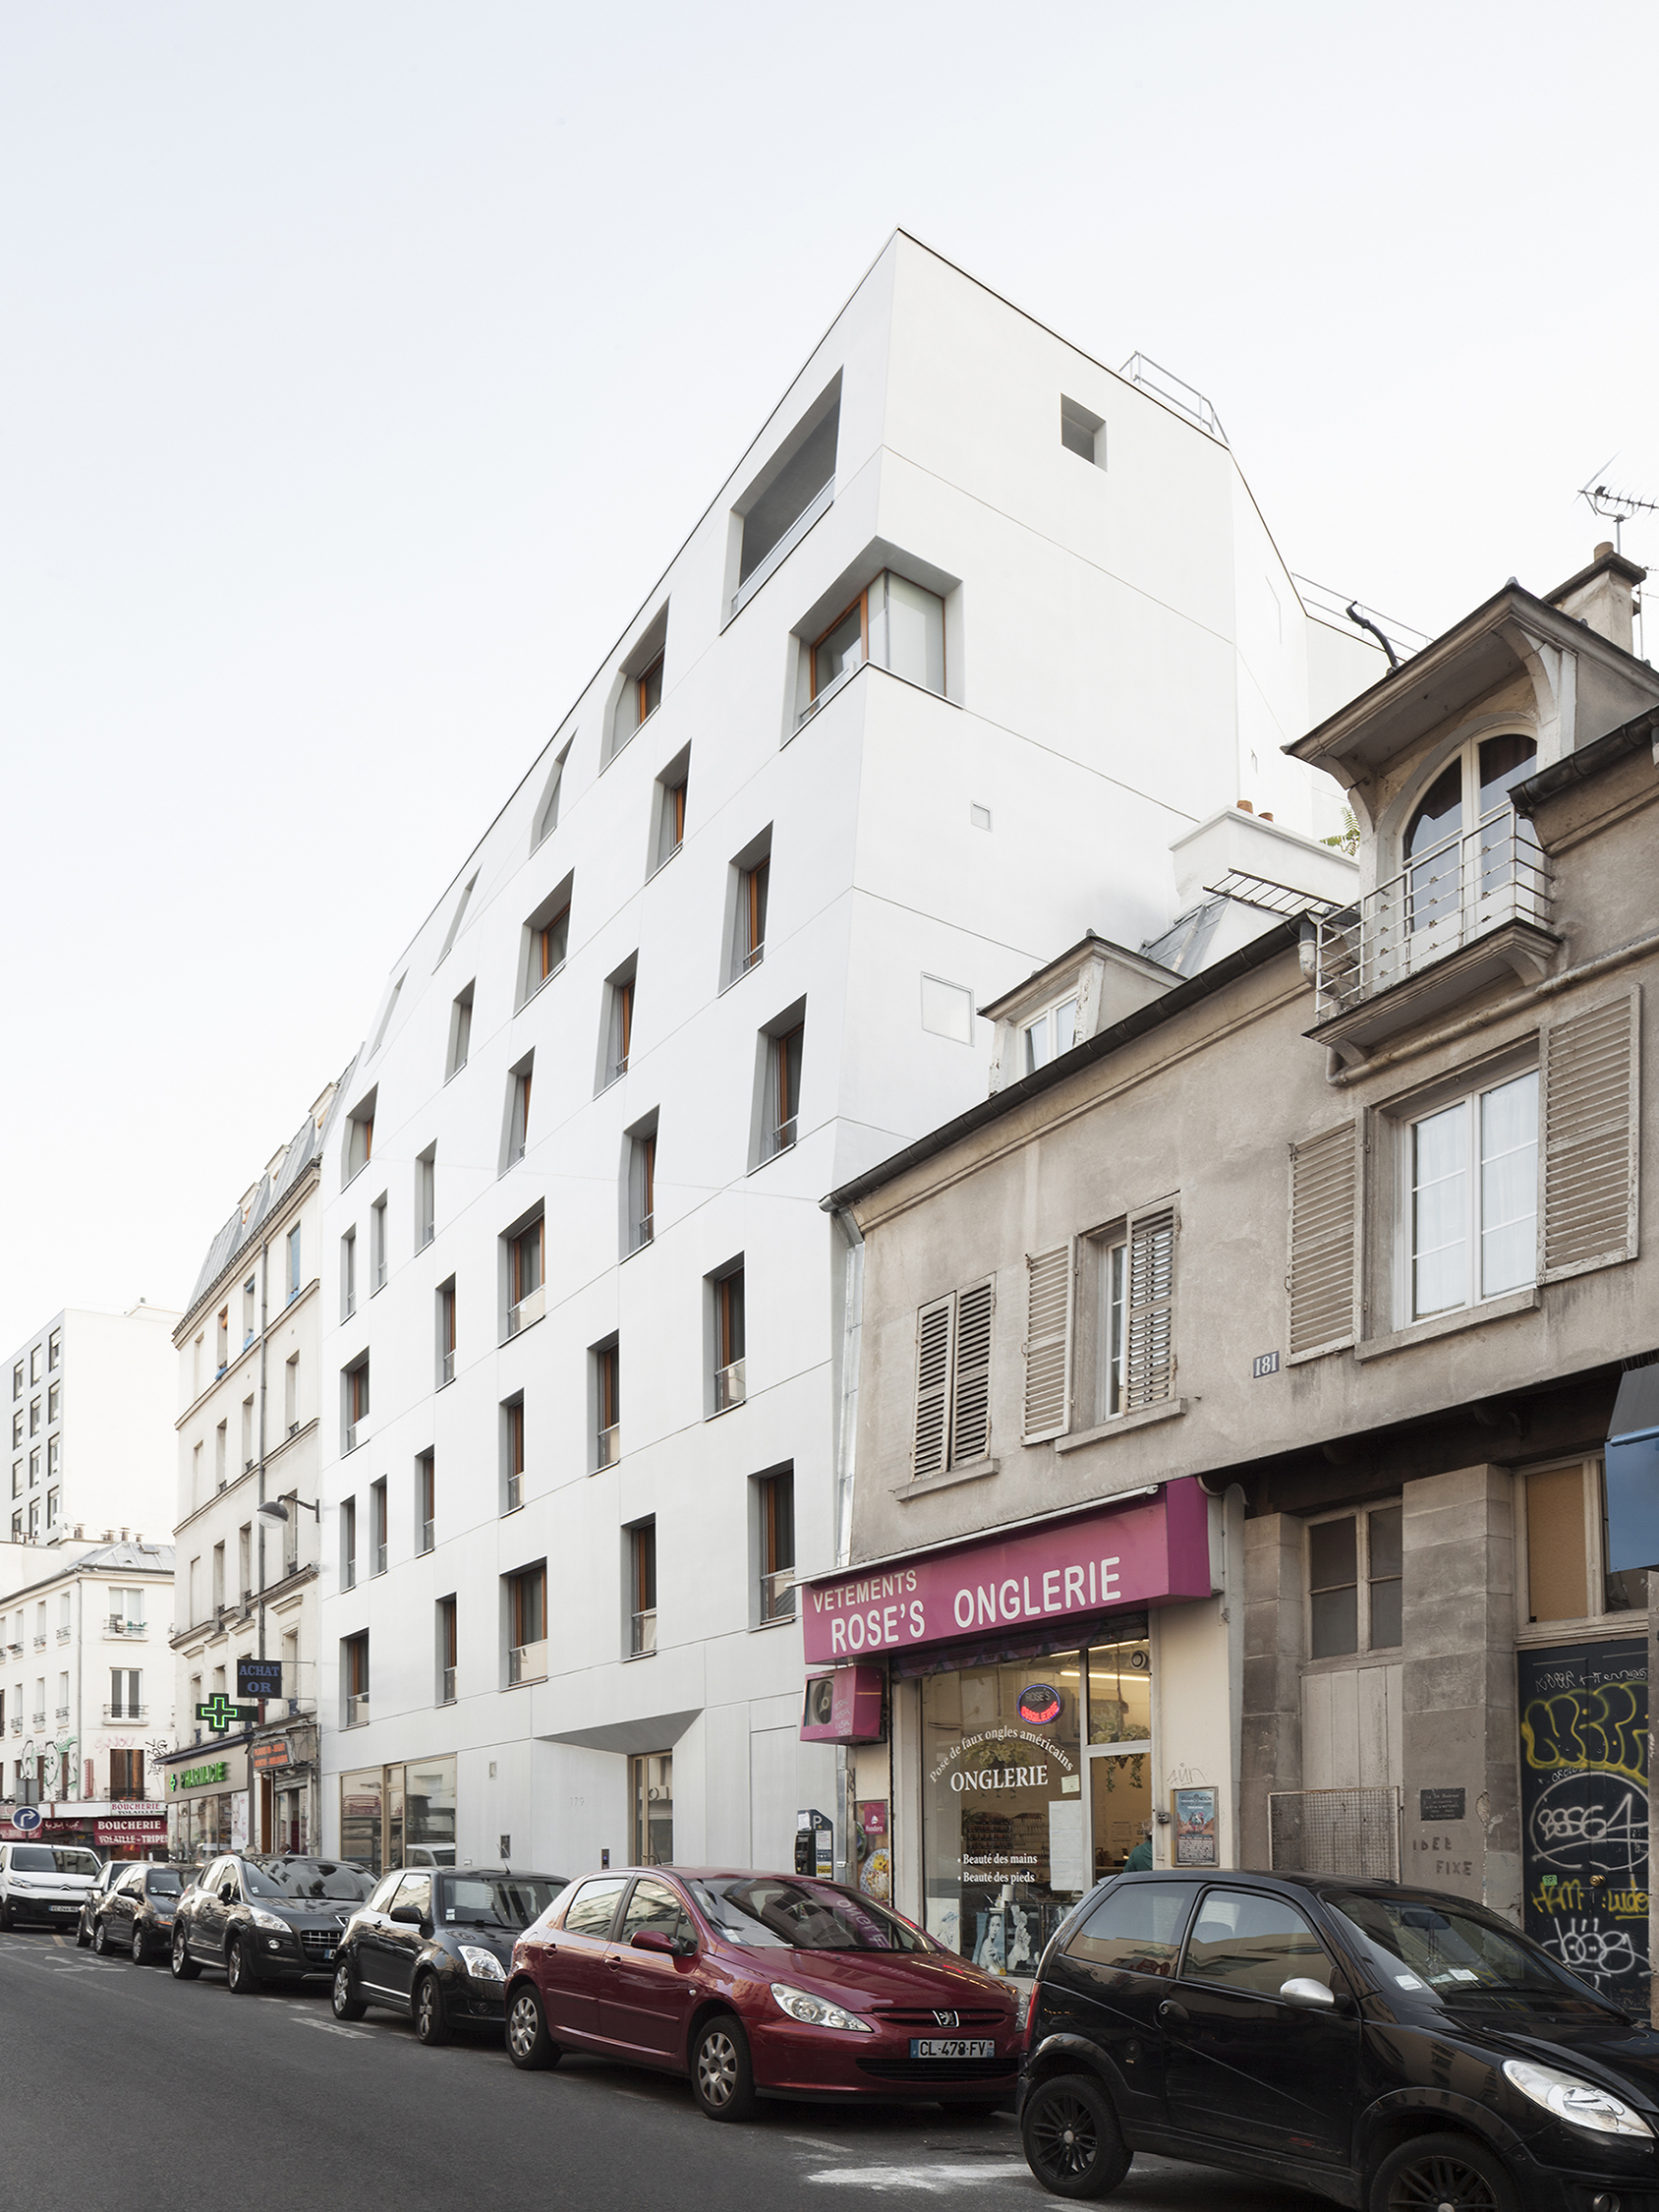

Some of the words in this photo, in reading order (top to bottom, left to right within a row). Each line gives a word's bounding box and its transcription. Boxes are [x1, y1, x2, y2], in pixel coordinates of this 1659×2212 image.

[1255, 1353, 1277, 1376] 181
[813, 1570, 917, 1613] VETEMENTS
[831, 1600, 925, 1654] ROSE'S
[954, 1556, 1121, 1628] ONGLERIE
[239, 1665, 281, 1676] ACHAT
[247, 1682, 272, 1693] OR
[929, 1757, 949, 1782] Pose
[949, 1745, 961, 1759] de
[961, 1733, 983, 1750] faux
[985, 1725, 1018, 1741] ongles
[1020, 1730, 1074, 1772] américains
[180, 1762, 227, 1789] PHARMACIE
[950, 1765, 1049, 1792] ONGLERIE
[98, 1821, 161, 1830] BOUCHERIE
[963, 1853, 992, 1864] Beauté
[994, 1853, 1008, 1864] des
[1010, 1853, 1038, 1864] mains
[1436, 1860, 1472, 1876] FIXE
[963, 1872, 992, 1883] Beauté
[994, 1872, 1008, 1883] des
[1010, 1872, 1035, 1885] pieds
[920, 2041, 986, 2056] CL-478-FV
